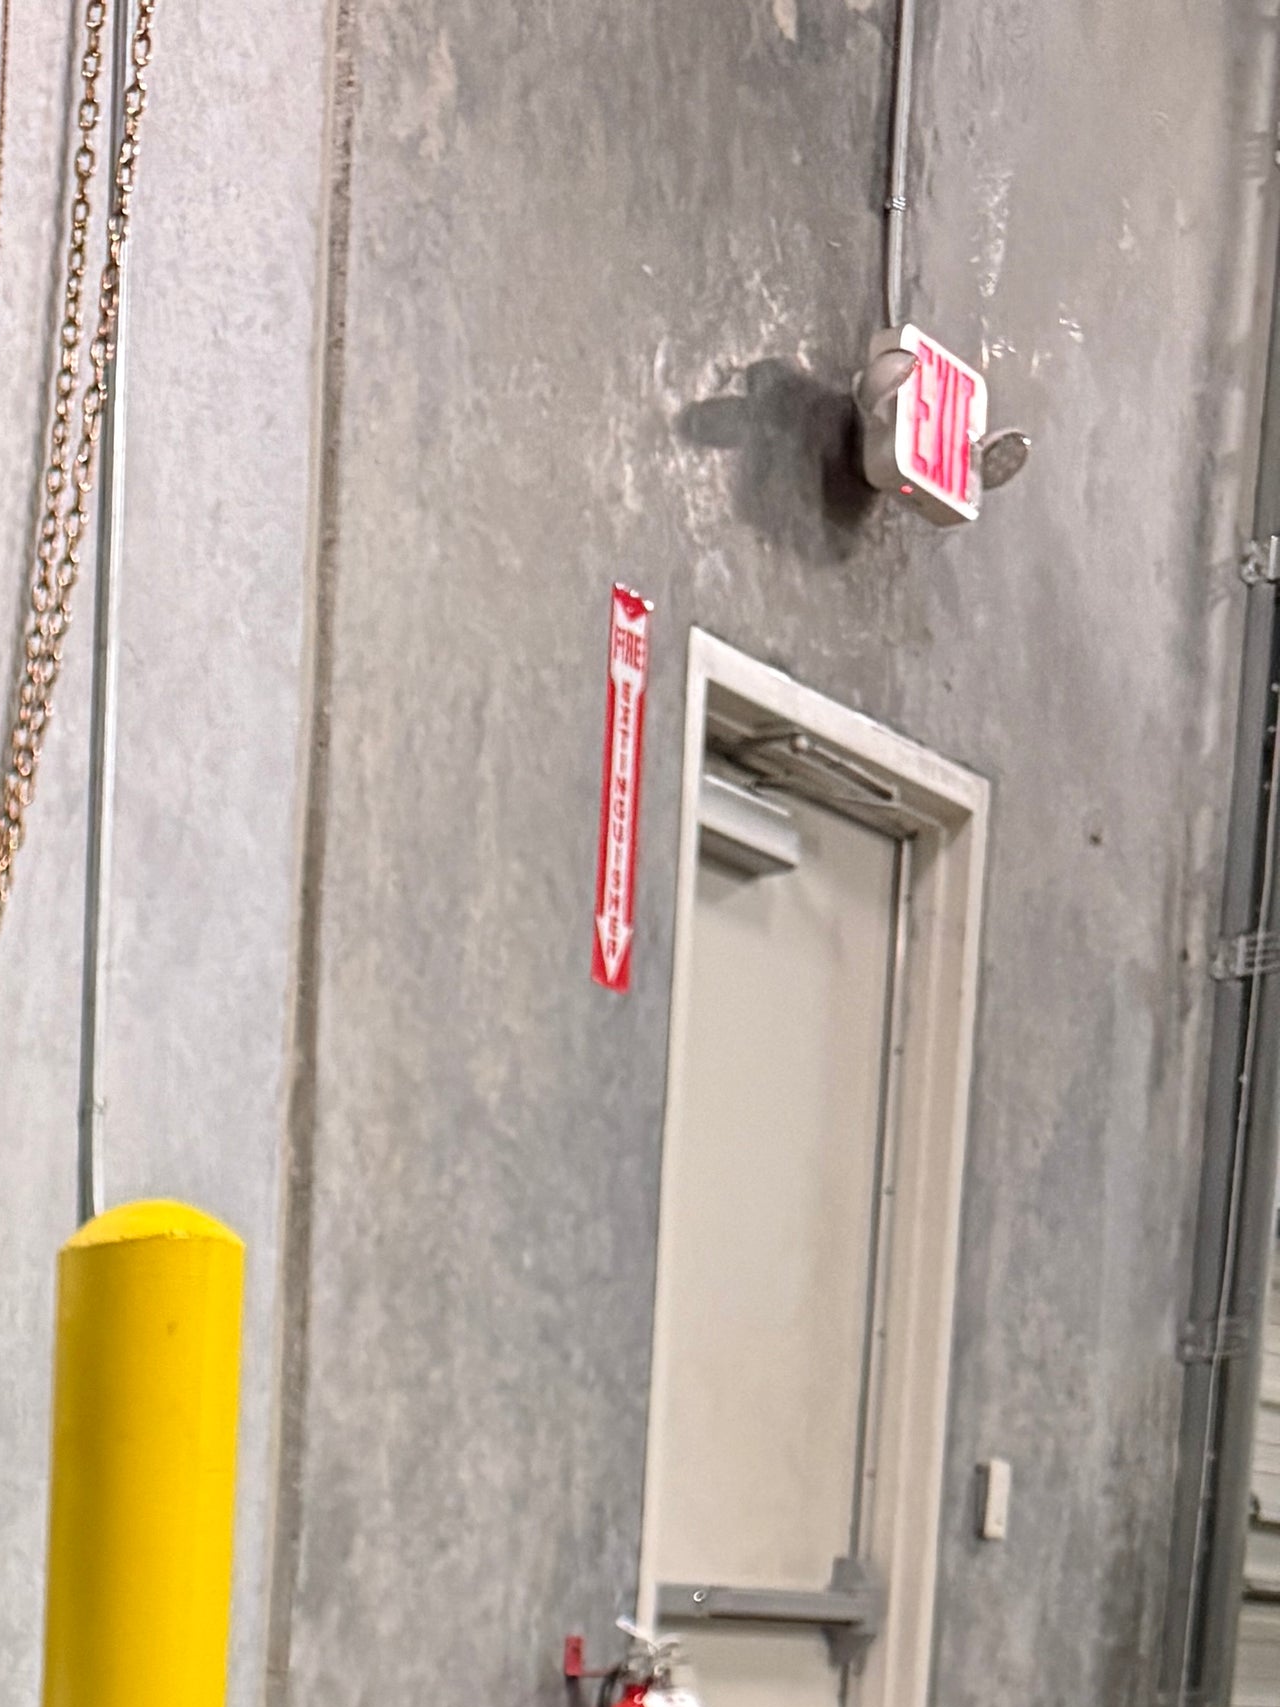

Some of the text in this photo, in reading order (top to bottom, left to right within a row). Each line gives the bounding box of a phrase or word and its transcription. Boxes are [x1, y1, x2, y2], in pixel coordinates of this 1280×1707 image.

[911, 339, 976, 504] EXIT
[613, 626, 647, 670] FIRE
[606, 680, 631, 958] EXTINGUISHER
